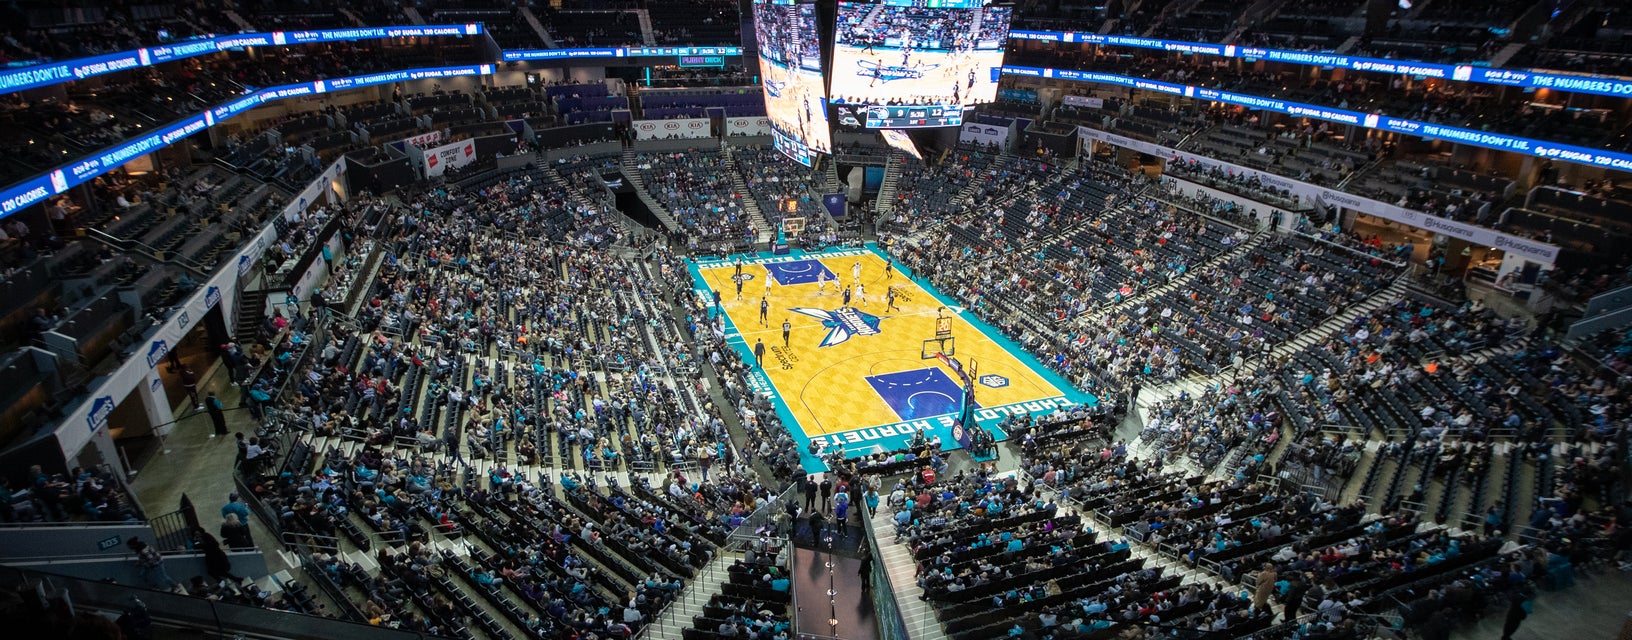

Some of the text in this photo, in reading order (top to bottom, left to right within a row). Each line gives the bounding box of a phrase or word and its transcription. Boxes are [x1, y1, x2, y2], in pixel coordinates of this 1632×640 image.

[1282, 53, 1312, 62] NUMBERS
[1313, 55, 1336, 64] DON'T
[1409, 67, 1444, 77] CALORIES.
[1532, 76, 1554, 85] THE
[1554, 78, 1612, 91] NUMBERS
[1231, 95, 1256, 104] NUMBERS
[1256, 99, 1274, 107] DON'T
[897, 109, 904, 117] 9
[1423, 126, 1439, 134] THE
[1440, 129, 1481, 141] NUMBERS
[1481, 135, 1513, 146] DON'T
[1512, 139, 1529, 149] LIE.
[440, 147, 460, 158] COMFORT
[445, 155, 457, 164] ZONE
[1547, 149, 1560, 157] OF
[1560, 150, 1593, 162] SUGAR.
[1594, 156, 1612, 165] 120
[15, 187, 48, 206] CALORIES.
[1328, 193, 1361, 207] Husqvarna
[1432, 221, 1474, 237] Husqvarna
[1503, 239, 1551, 258] Husqvarna
[810, 397, 1074, 448] CHARLOTE HORNETS
[101, 537, 118, 548] 103
